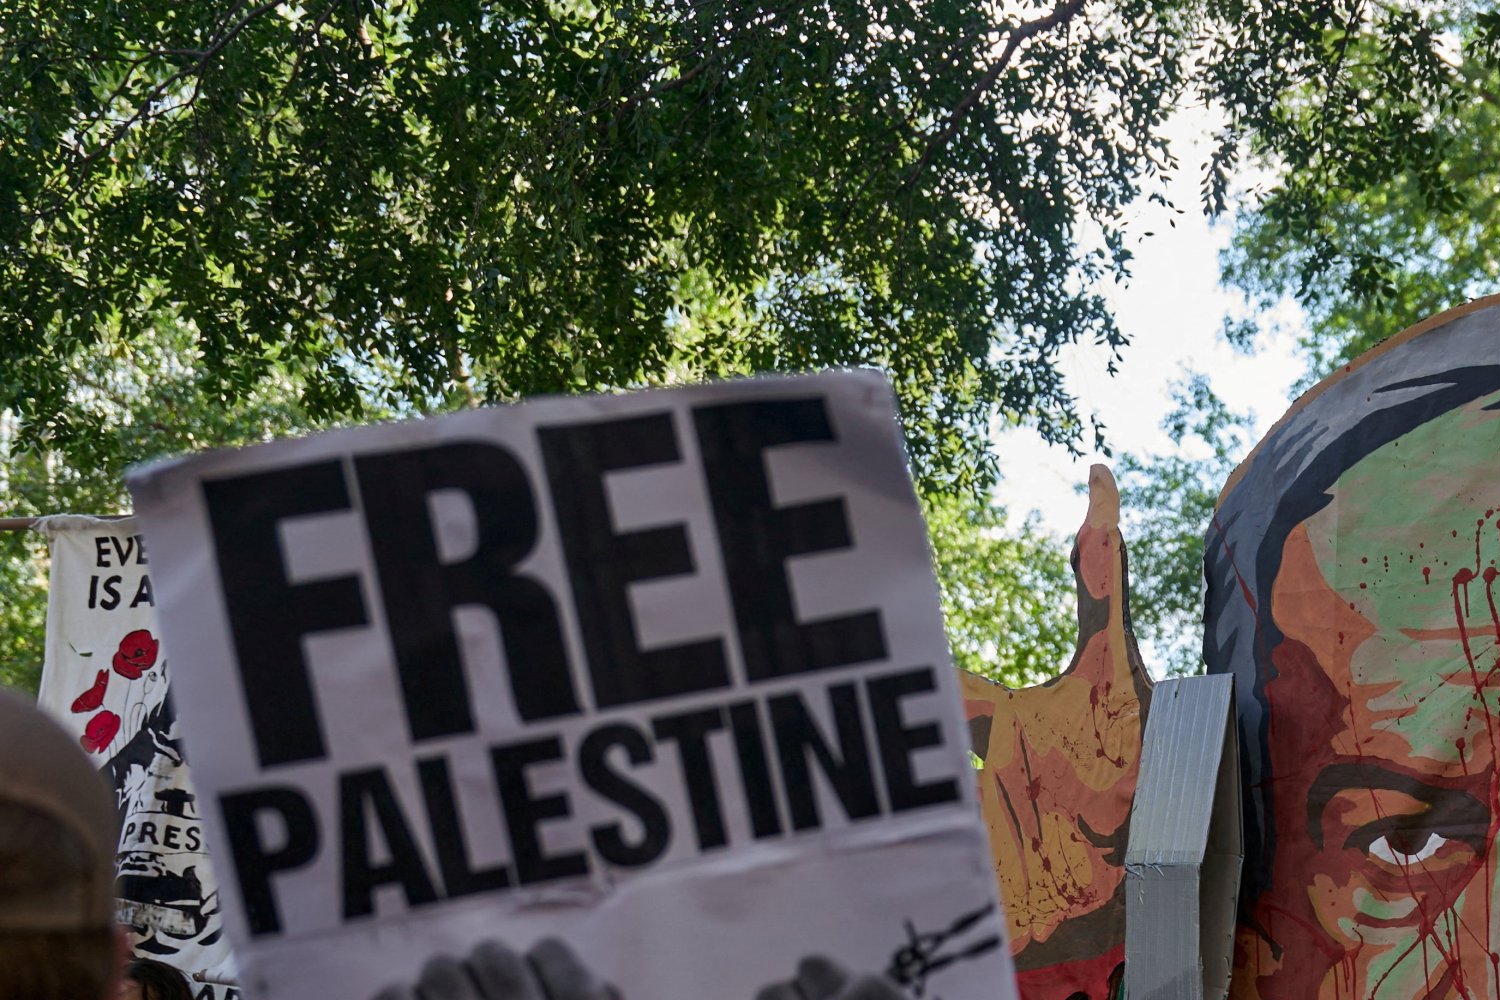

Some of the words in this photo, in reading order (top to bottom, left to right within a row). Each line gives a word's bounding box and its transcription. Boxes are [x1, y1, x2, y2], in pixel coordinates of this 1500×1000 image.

[88, 574, 122, 611] IS
[129, 574, 155, 608] A
[201, 396, 890, 770] FREE
[123, 821, 201, 852] PRES
[218, 666, 963, 936] PALESTINE
